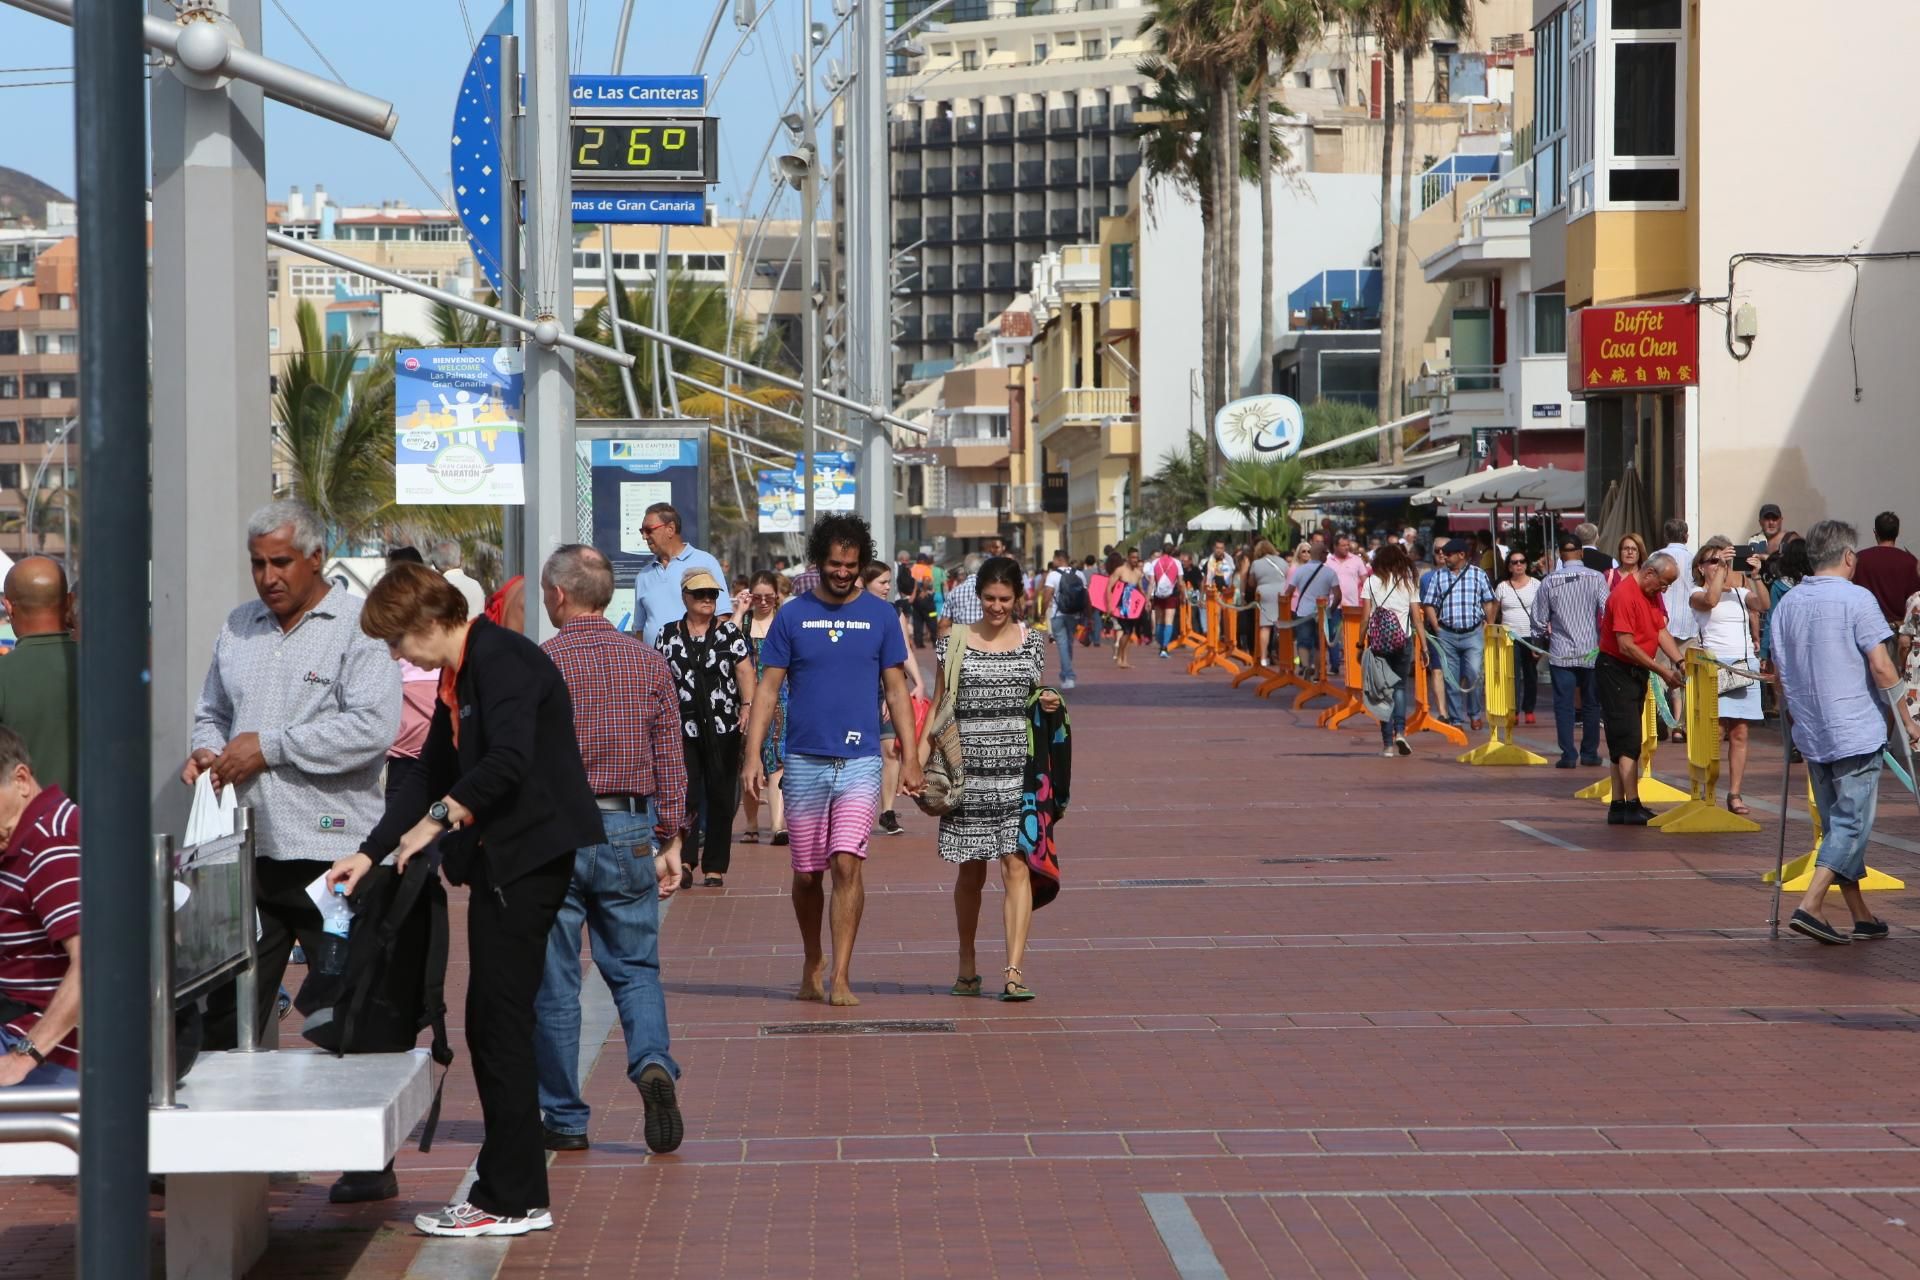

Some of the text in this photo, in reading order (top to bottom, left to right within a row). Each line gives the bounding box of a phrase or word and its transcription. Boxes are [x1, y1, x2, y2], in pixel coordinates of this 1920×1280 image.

[573, 86, 698, 100] de Las Canteras
[571, 200, 696, 211] mas de Gran Canaria
[1614, 310, 1664, 335] Buffet
[1600, 336, 1678, 359] Casa Chen
[445, 372, 476, 380] Palmas
[432, 380, 486, 388] Gran Canaria
[423, 440, 437, 450] 24
[834, 619, 845, 629] de
[846, 620, 871, 630] futuro
